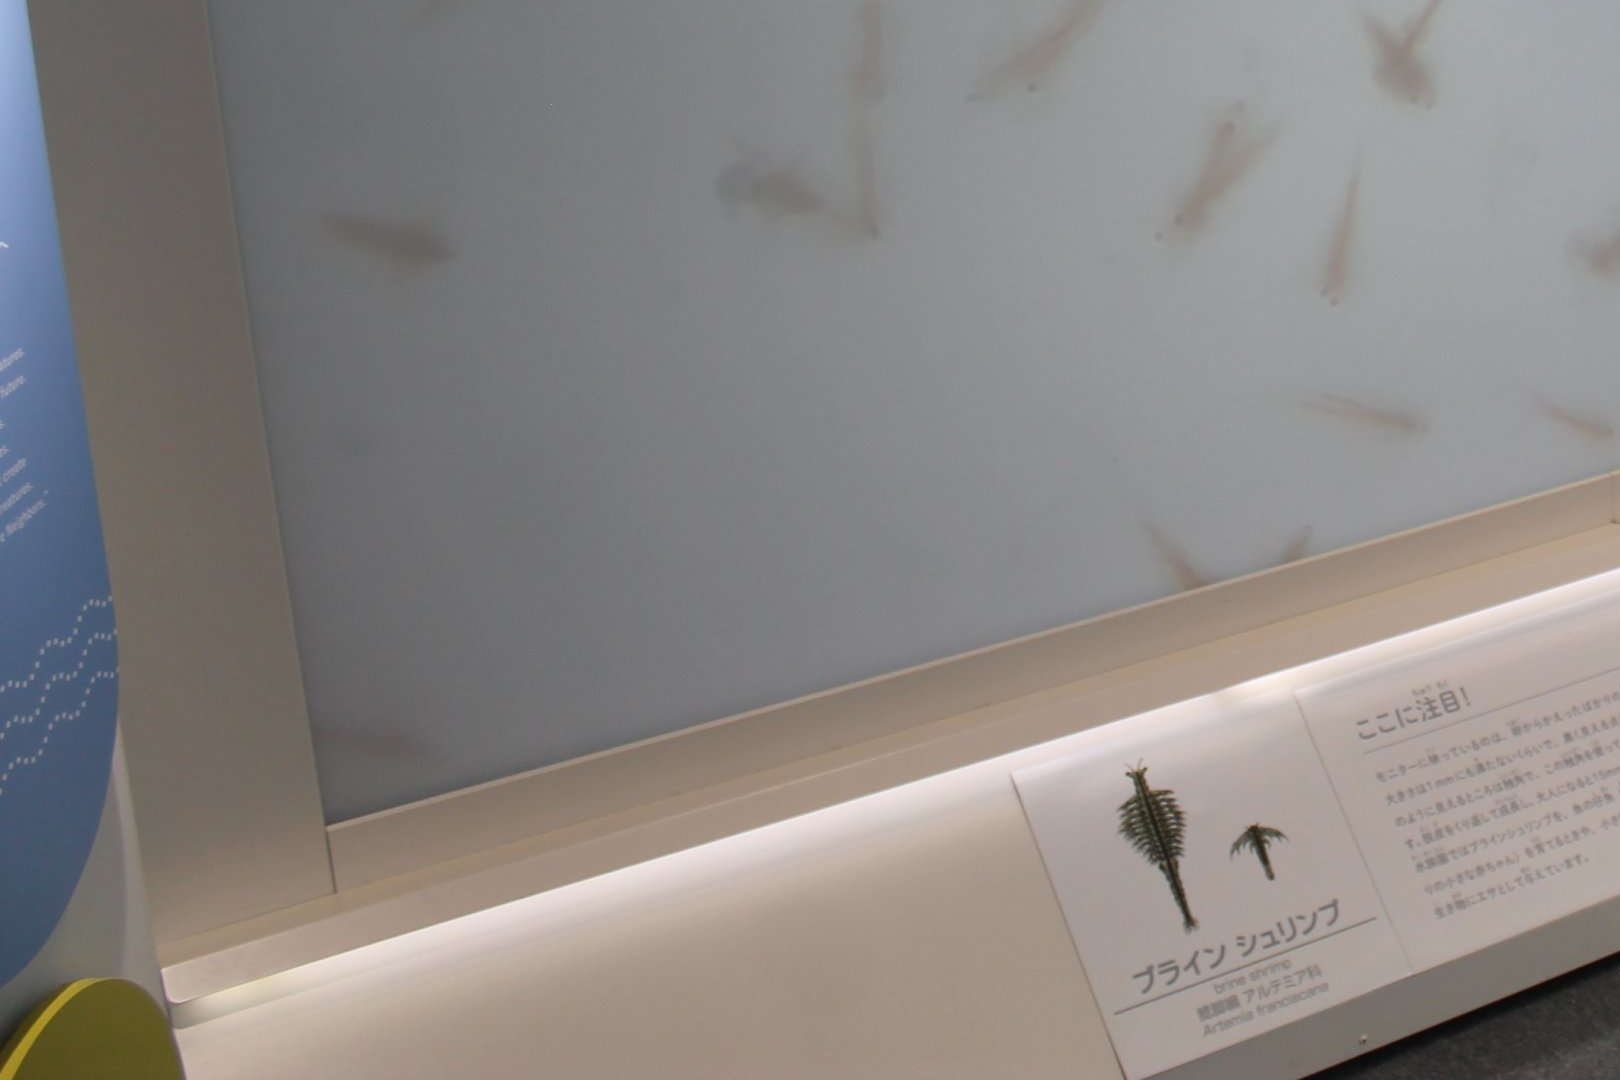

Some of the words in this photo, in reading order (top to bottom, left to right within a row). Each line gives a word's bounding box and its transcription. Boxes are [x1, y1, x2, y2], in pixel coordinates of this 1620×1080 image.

[1355, 686, 1471, 740] ここに注目！
[1132, 944, 1226, 995] ブライン
[1235, 898, 1340, 957] シュリンプ
[1213, 976, 1248, 995] brine
[1249, 959, 1292, 982] shrimp
[1242, 964, 1322, 1004] アルテミア科
[1203, 1010, 1255, 1037] Artemia
[1256, 982, 1330, 1017] franciscana
